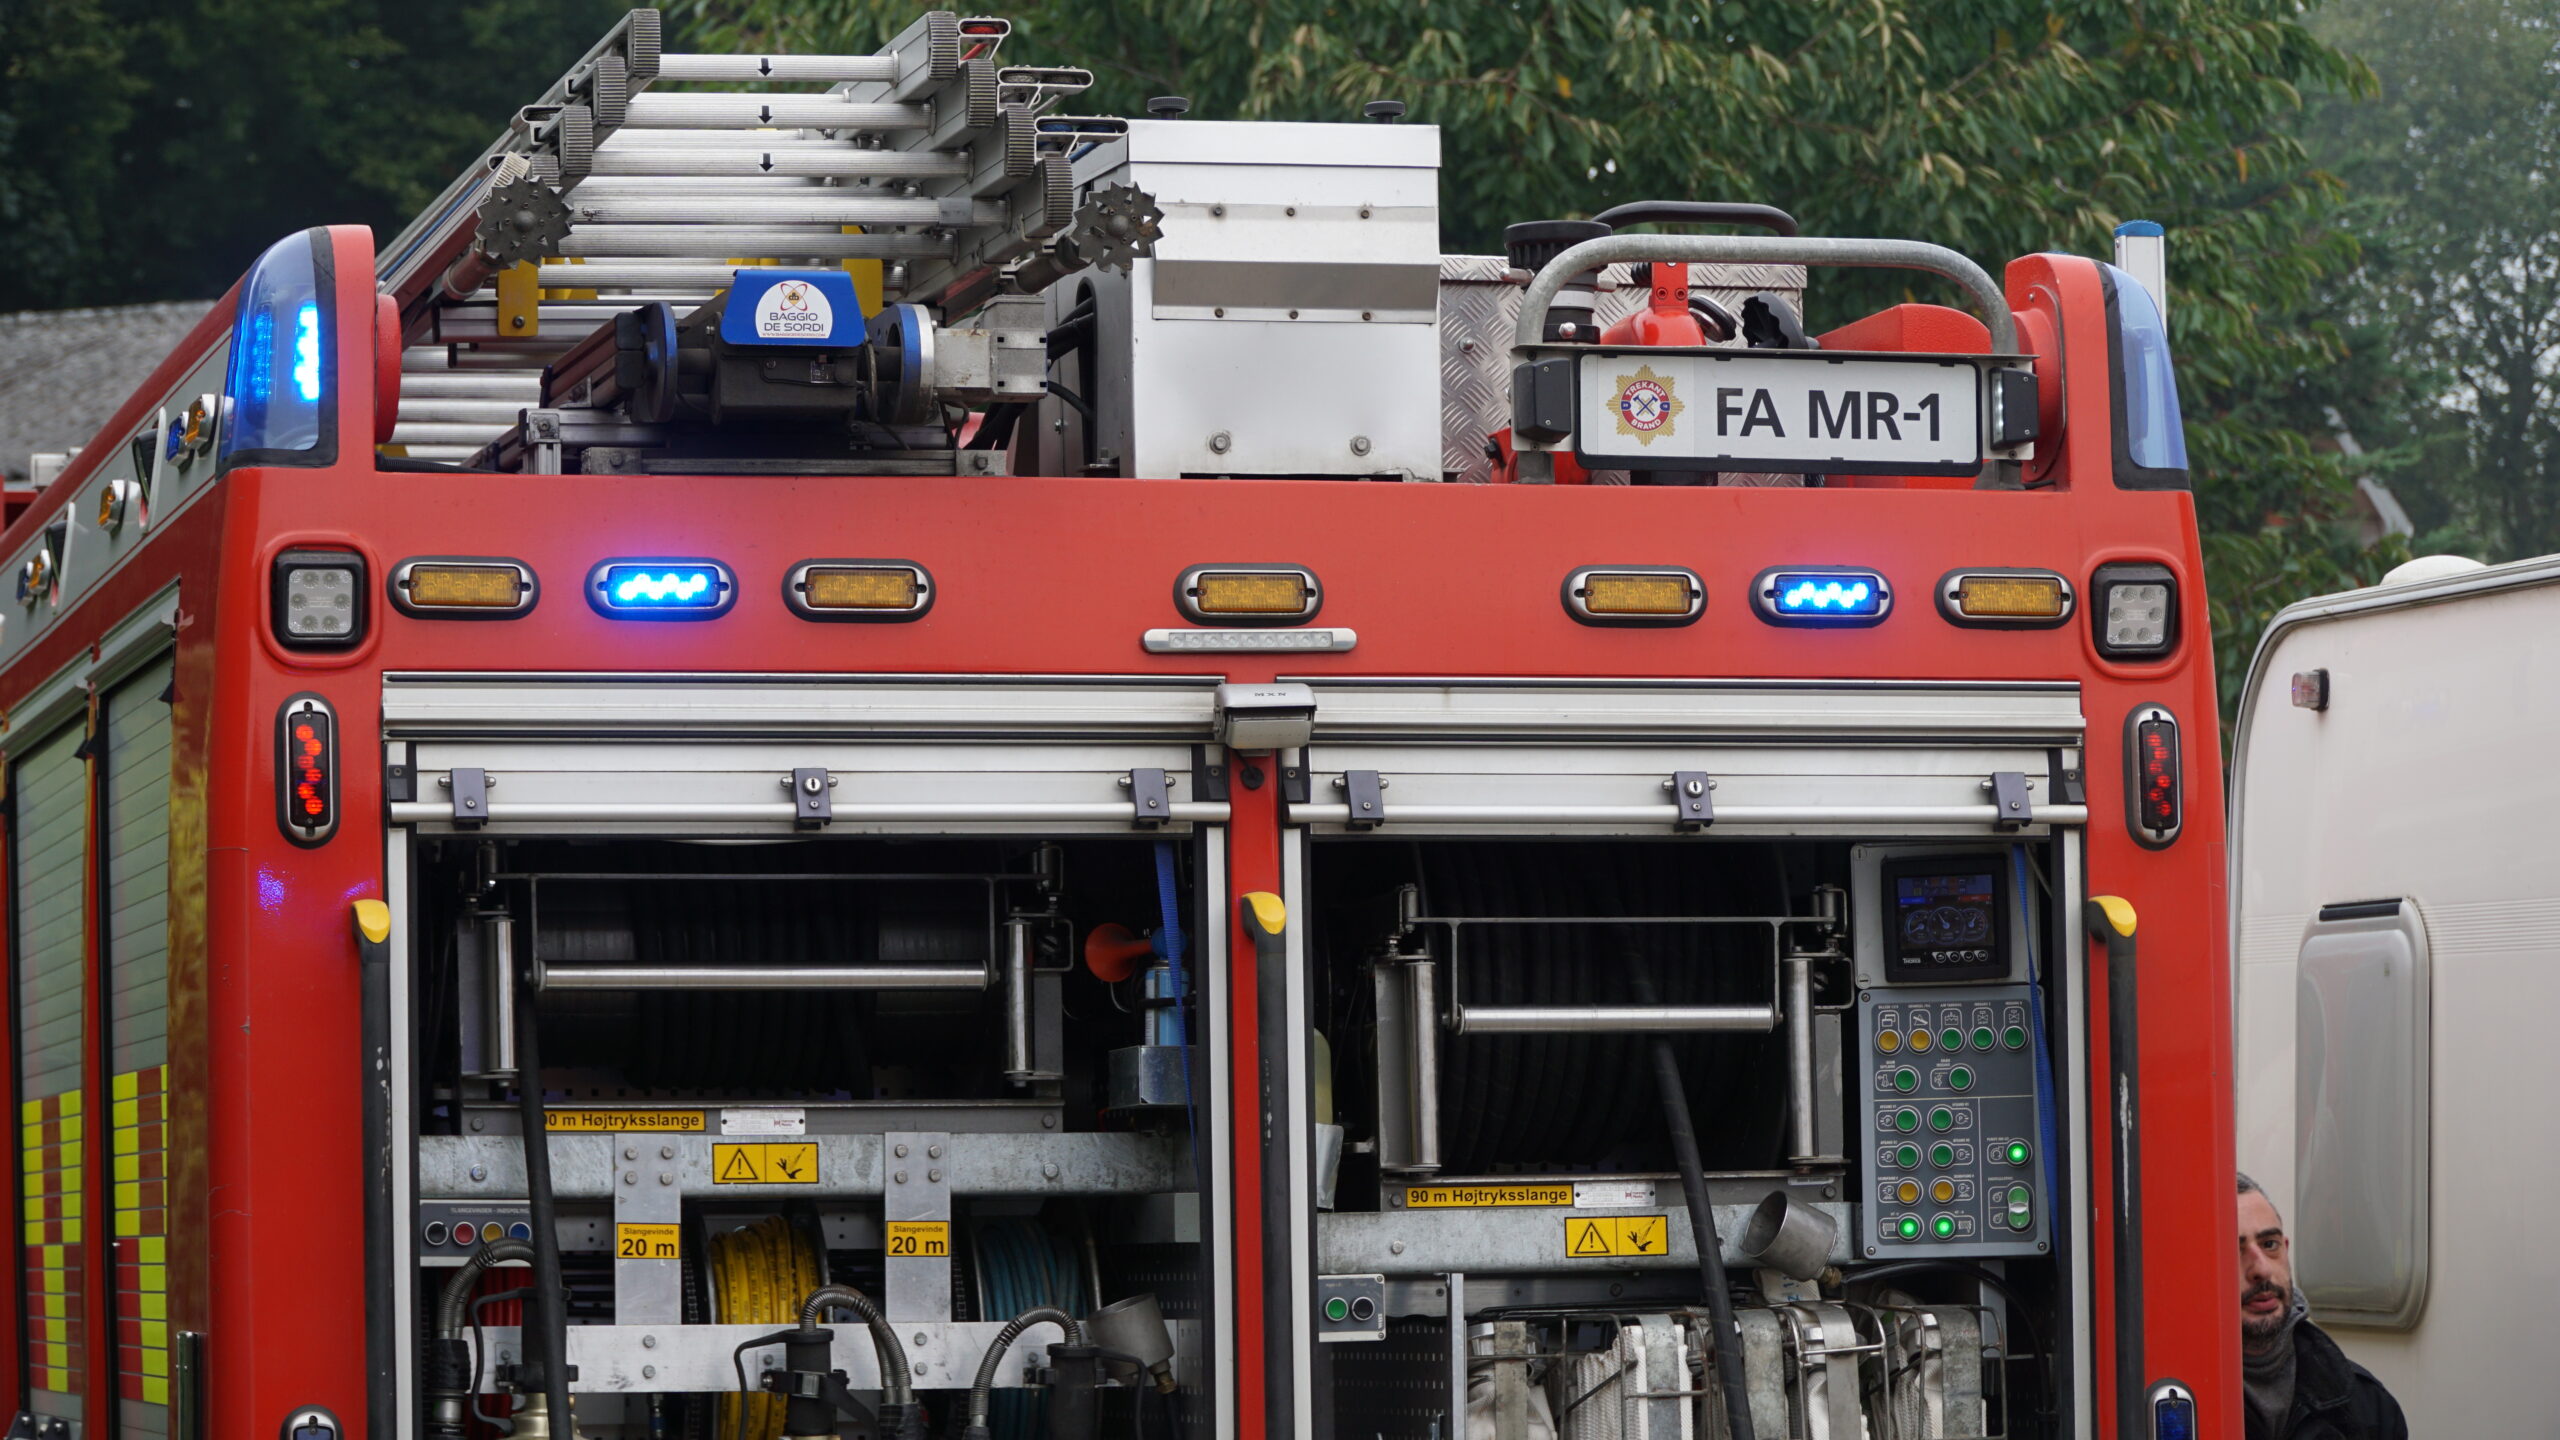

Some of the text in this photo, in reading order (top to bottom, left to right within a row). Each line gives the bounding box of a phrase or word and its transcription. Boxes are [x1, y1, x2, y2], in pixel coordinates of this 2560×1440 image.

[769, 312, 818, 322] BAGGIO
[764, 323, 824, 332] DE SORDI
[1625, 381, 1666, 397] TREKANT
[1716, 387, 1940, 442] FA MR-1
[1631, 418, 1661, 430] BRAND
[562, 1116, 576, 1126] m
[582, 1113, 700, 1130] Højtryksslange
[1411, 1190, 1429, 1203] 90
[1433, 1193, 1447, 1202] m
[1452, 1189, 1568, 1205] Højtryksslange
[624, 1228, 674, 1236] Slangevinde
[894, 1226, 944, 1234] Slangevinde
[622, 1238, 675, 1256] 20 m
[891, 1236, 944, 1254] 20 m
